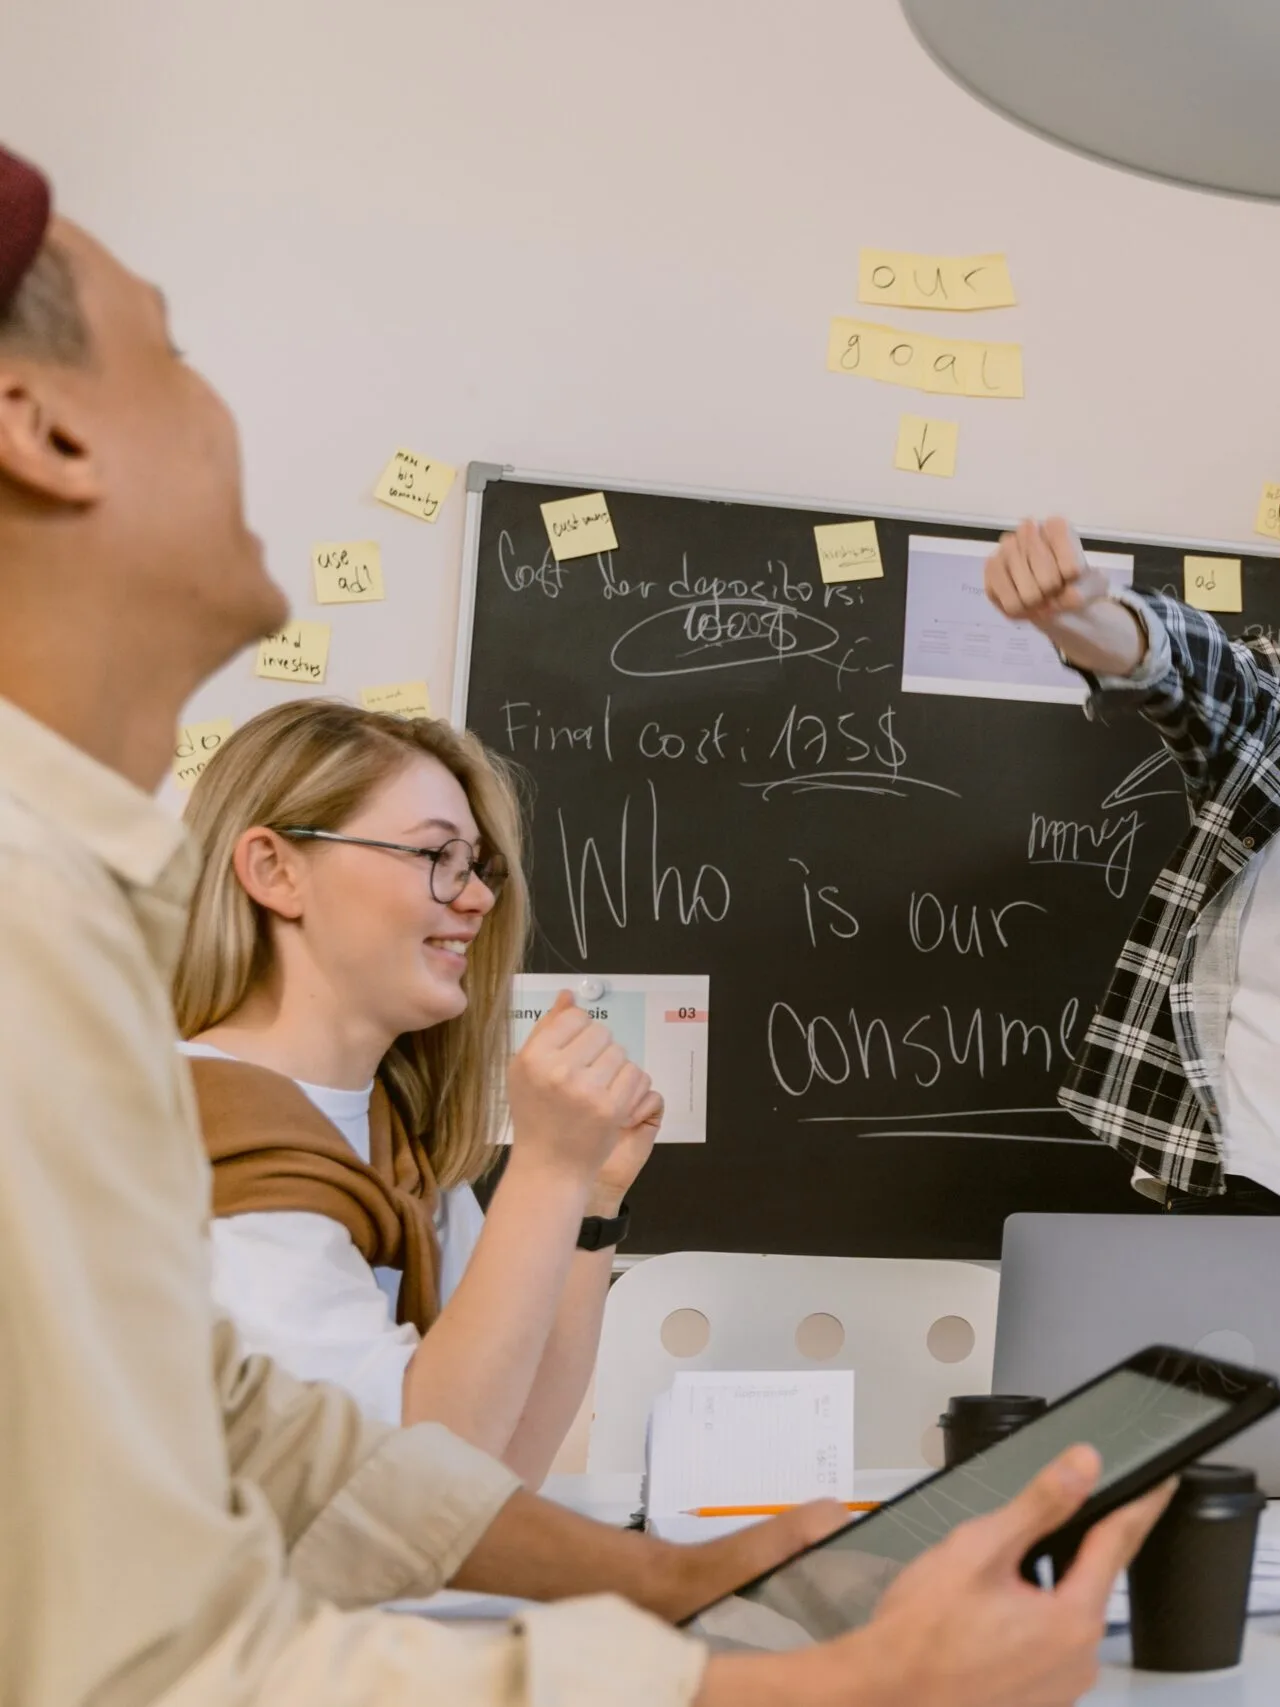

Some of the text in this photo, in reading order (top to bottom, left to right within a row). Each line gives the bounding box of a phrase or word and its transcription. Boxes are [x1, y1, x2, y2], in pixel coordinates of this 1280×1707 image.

[871, 265, 988, 301] our
[839, 333, 1001, 390] goal
[397, 466, 415, 489] big
[317, 549, 350, 569] use
[262, 652, 322, 678] investors
[500, 694, 613, 762] Final
[770, 704, 908, 784] 175$
[557, 778, 1048, 960] Who is our
[678, 1007, 696, 1020] 03
